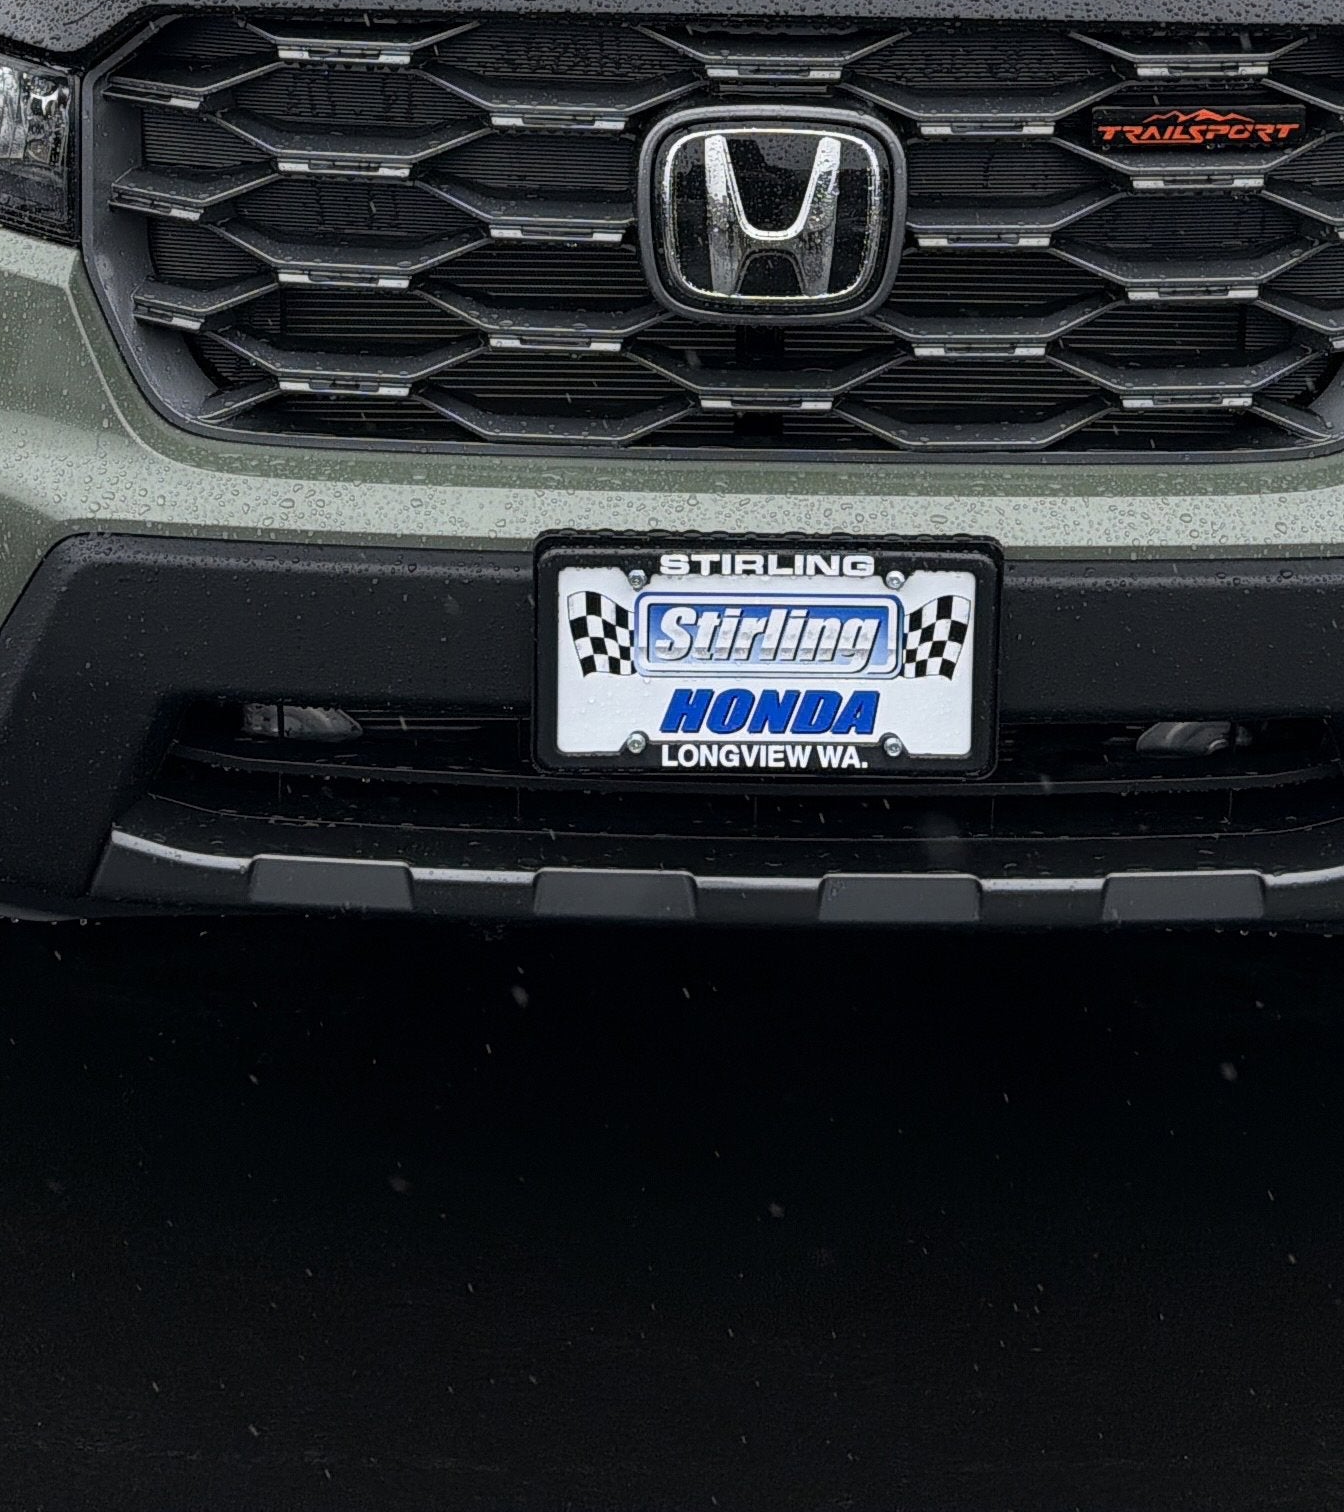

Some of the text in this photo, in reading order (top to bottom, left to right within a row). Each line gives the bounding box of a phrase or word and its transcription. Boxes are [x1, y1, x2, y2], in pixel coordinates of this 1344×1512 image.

[1097, 123, 1300, 144] TRAILSPORT
[659, 553, 876, 577] STIRLING
[655, 606, 880, 673] Stirling
[659, 688, 881, 735] HONDA
[661, 744, 869, 769] LONGVIEW WA.
